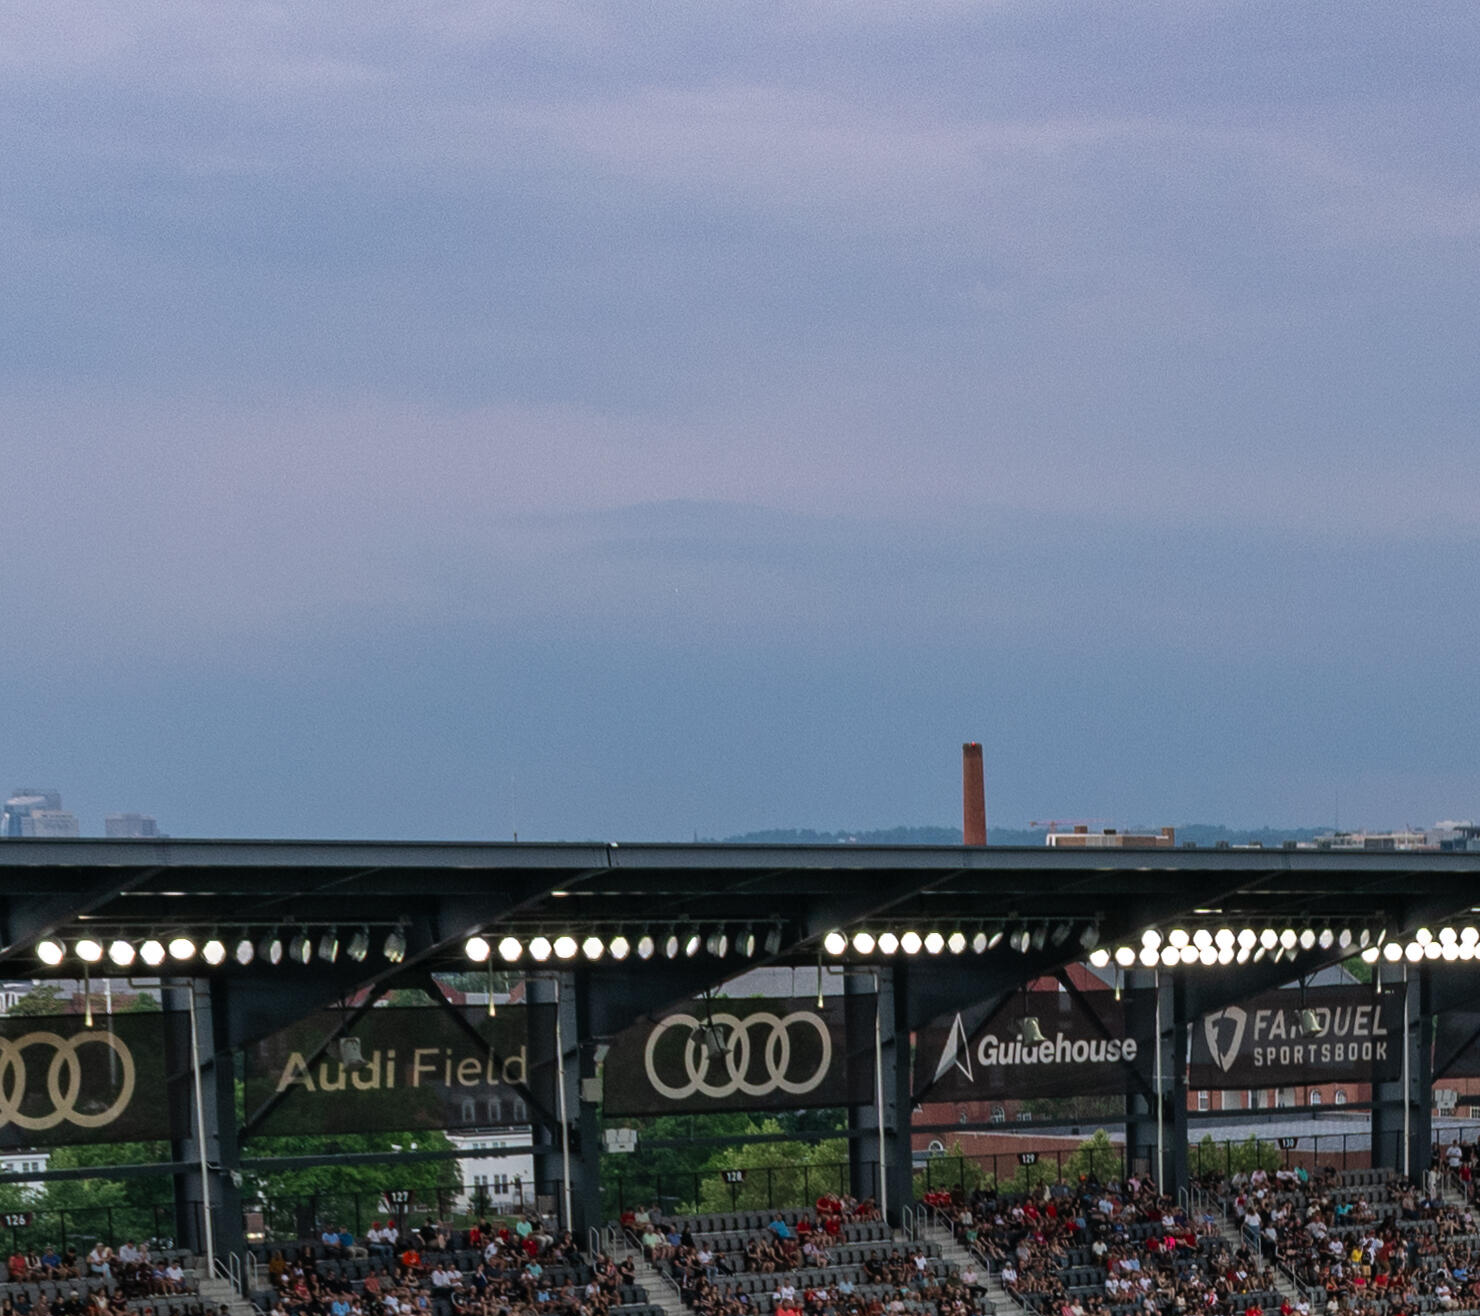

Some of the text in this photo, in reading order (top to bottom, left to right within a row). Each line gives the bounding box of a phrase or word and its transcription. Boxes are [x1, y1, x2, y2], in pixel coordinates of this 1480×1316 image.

[977, 1035, 1138, 1068] Guidehouse
[1254, 1042, 1387, 1067] SPORTSBOOK
[275, 1046, 529, 1093] Audi Field
[6, 1214, 26, 1227] 126
